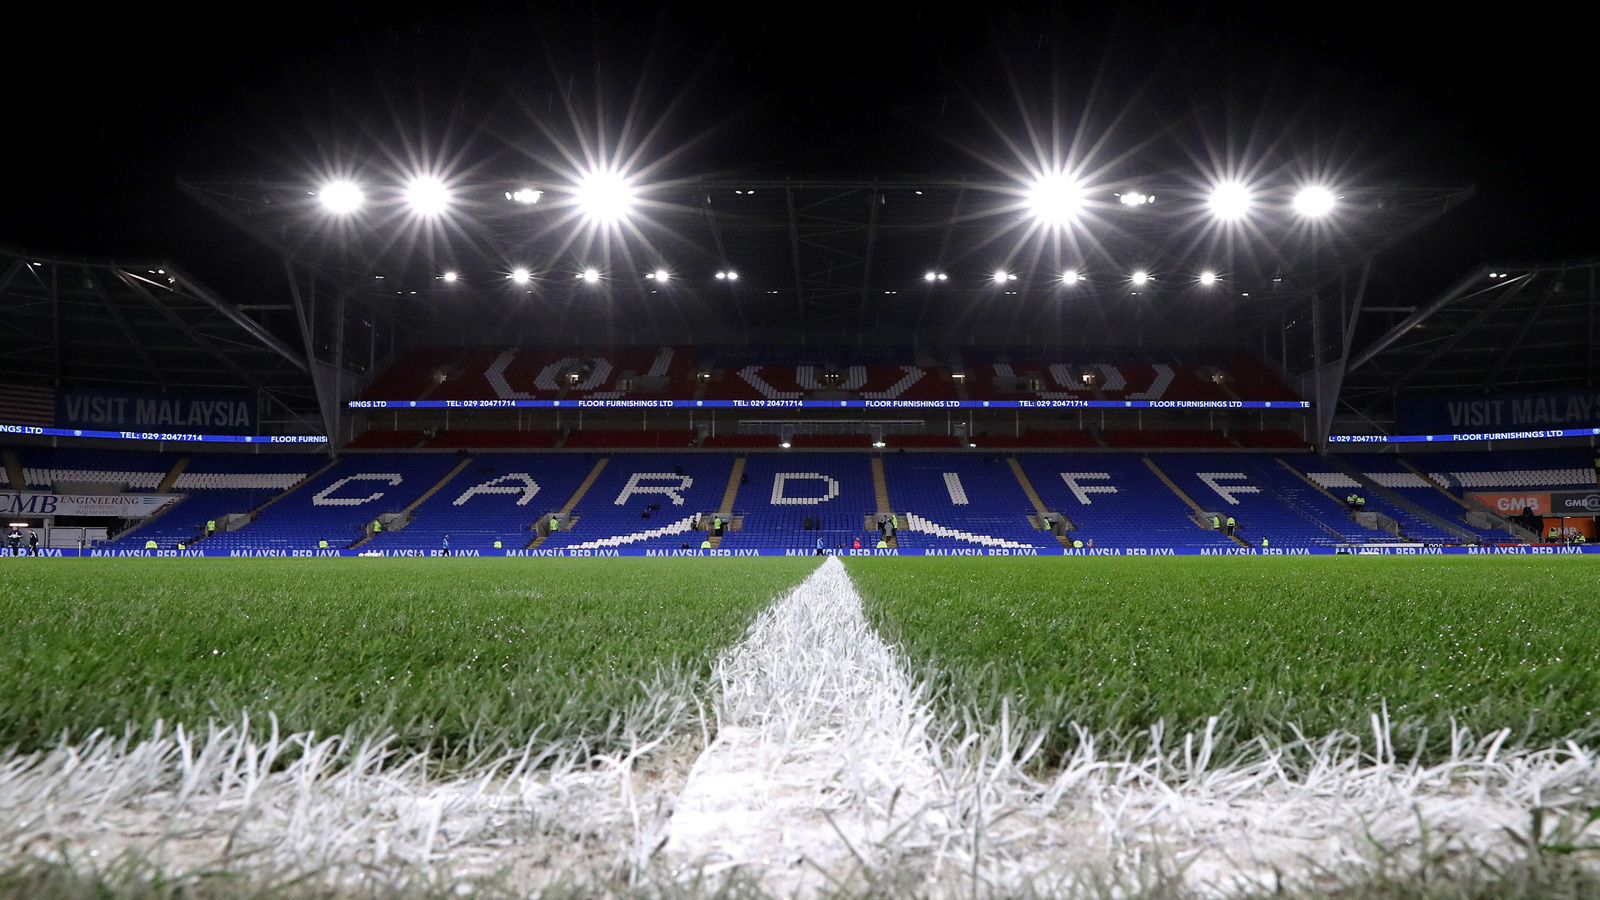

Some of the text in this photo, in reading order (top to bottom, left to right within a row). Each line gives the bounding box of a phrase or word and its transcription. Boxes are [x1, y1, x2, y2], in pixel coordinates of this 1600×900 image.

[65, 395, 250, 426] VISIT MALAYSIA
[1448, 400, 1505, 426] VISIT
[120, 431, 139, 439] TEL:
[1484, 431, 1544, 440] FURNISHINGS
[313, 473, 1261, 506] CARDIFF
[60, 496, 139, 504] ENGINEERING
[1497, 497, 1539, 511] GMB
